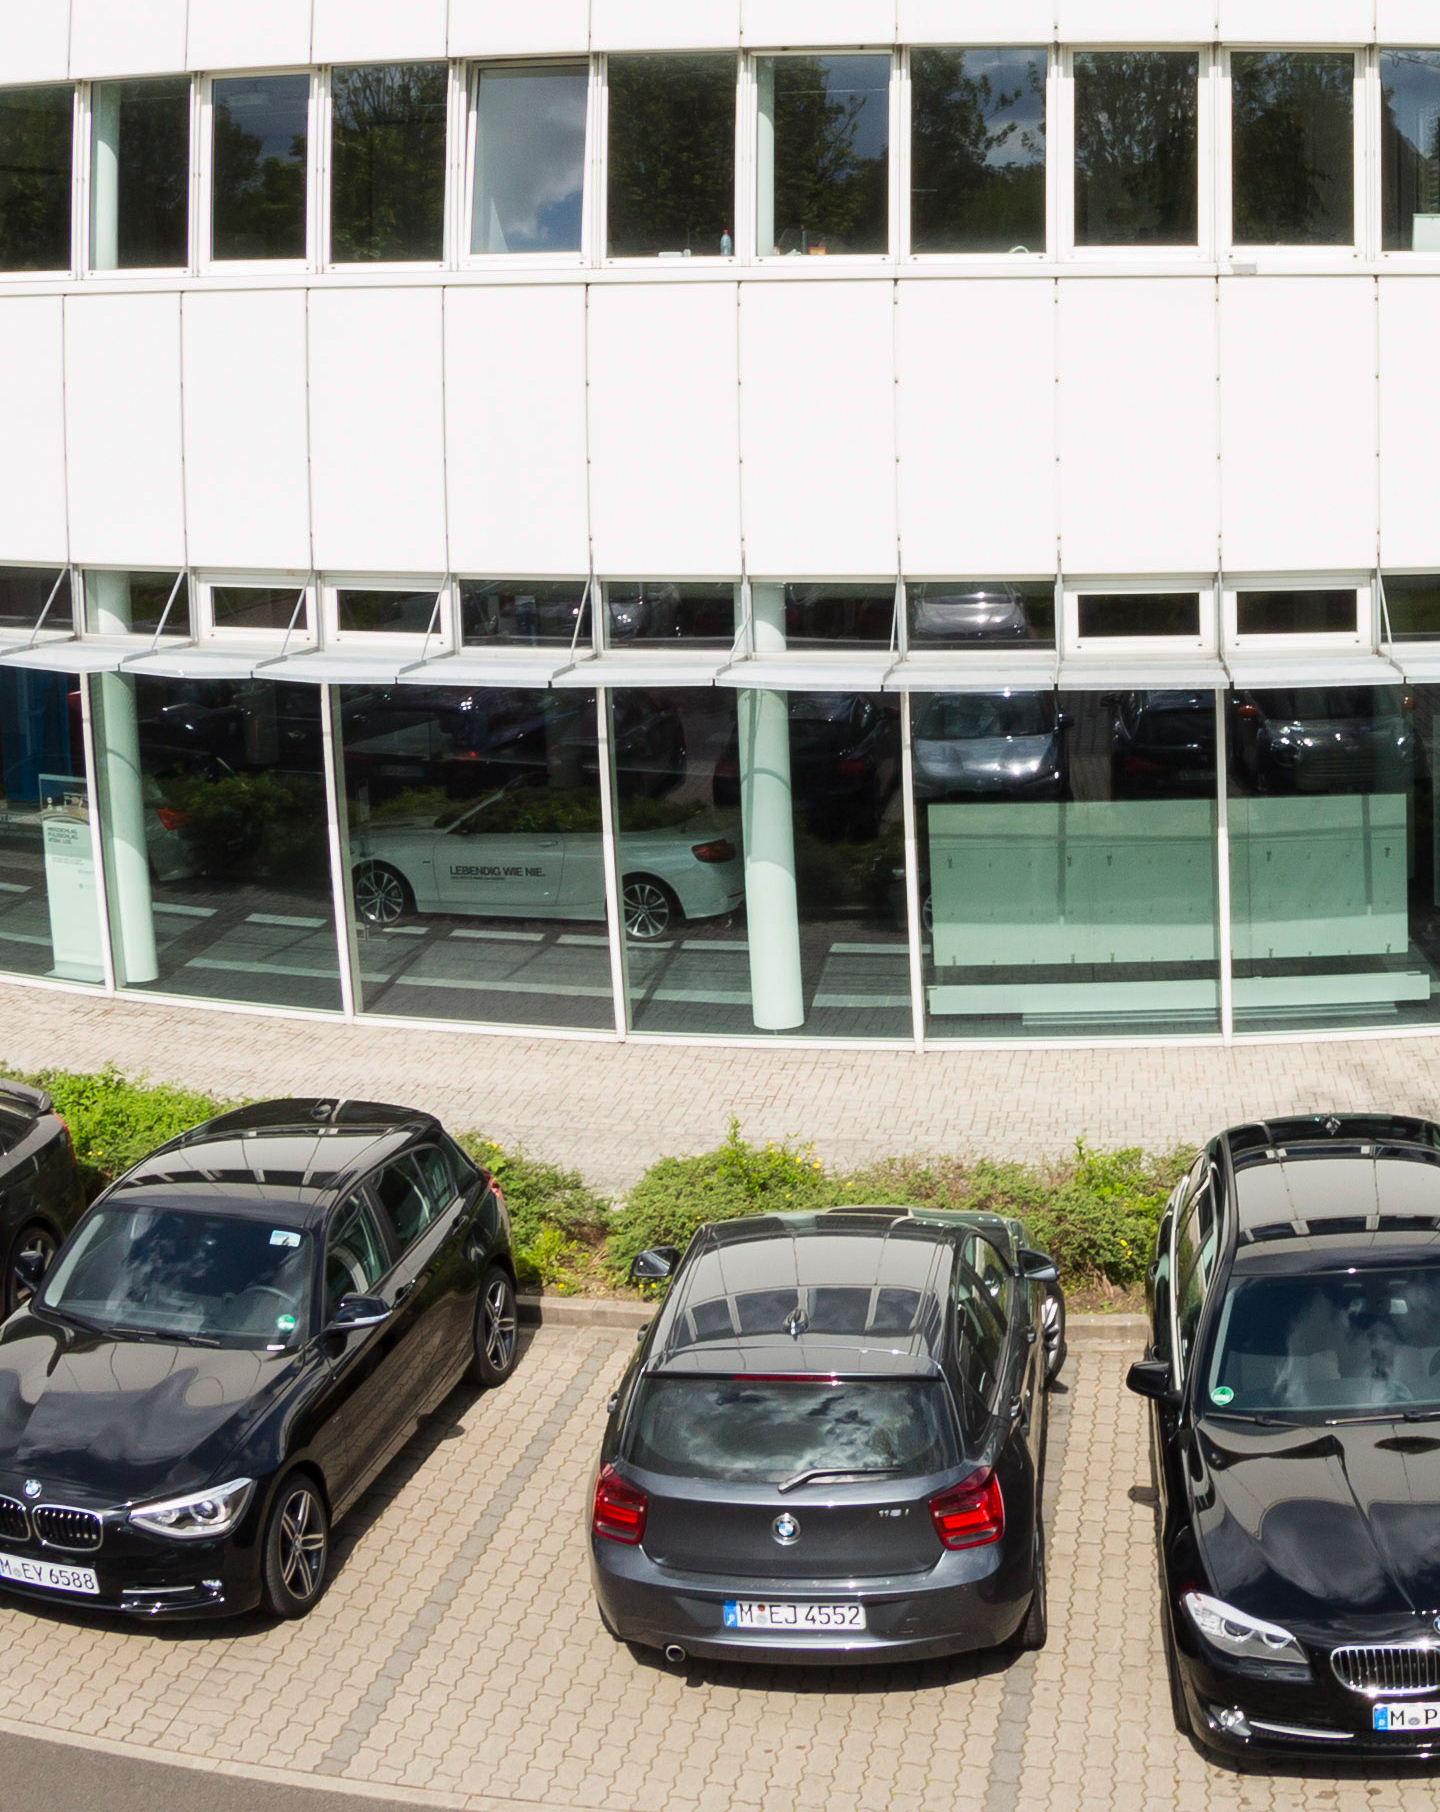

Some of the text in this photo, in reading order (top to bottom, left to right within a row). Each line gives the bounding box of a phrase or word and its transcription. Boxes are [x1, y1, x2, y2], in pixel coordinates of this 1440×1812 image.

[449, 865, 547, 878] LEBENDIG WIE NIE.
[21, 1562, 43, 1582] EY
[49, 1568, 95, 1590] 6588
[738, 1603, 862, 1625] M EJ 4552
[1390, 1709, 1405, 1726] M
